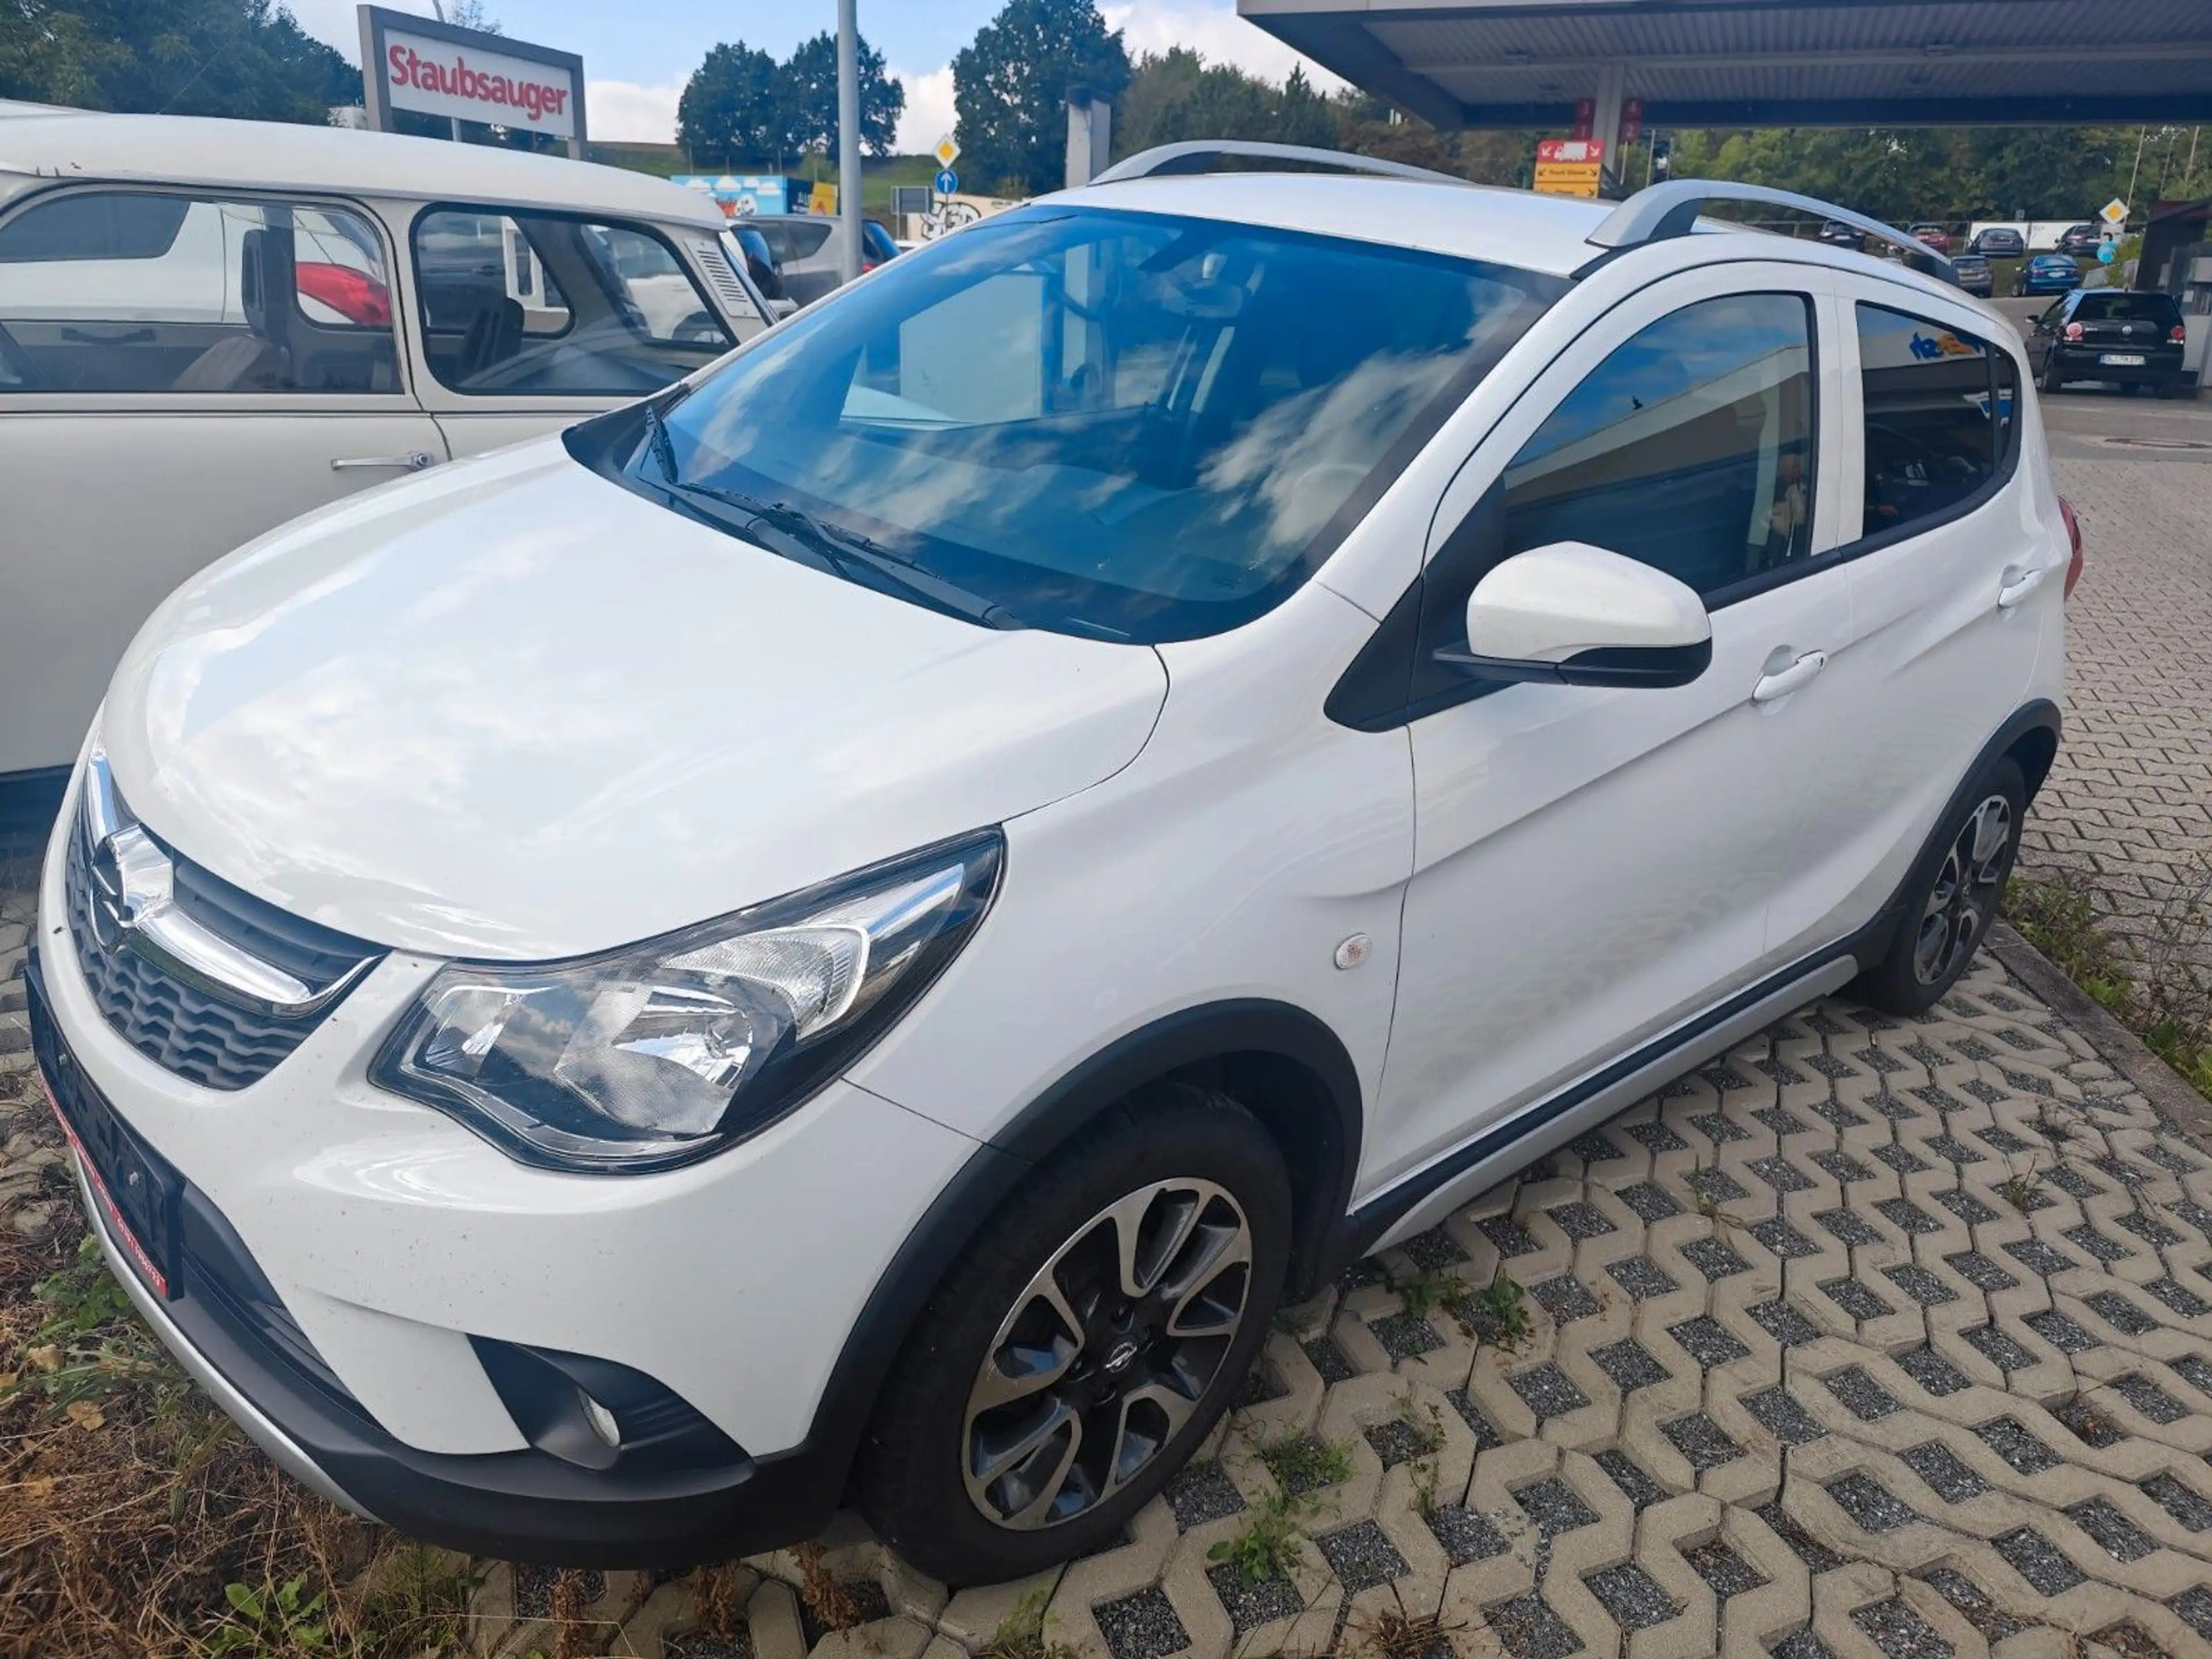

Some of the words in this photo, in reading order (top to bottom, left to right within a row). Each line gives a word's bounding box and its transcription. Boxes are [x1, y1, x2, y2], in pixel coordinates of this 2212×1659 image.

[389, 44, 567, 120] Staubsauger
[1582, 101, 1590, 115] 3
[1628, 101, 1638, 115] 4
[1626, 123, 1634, 137] 2
